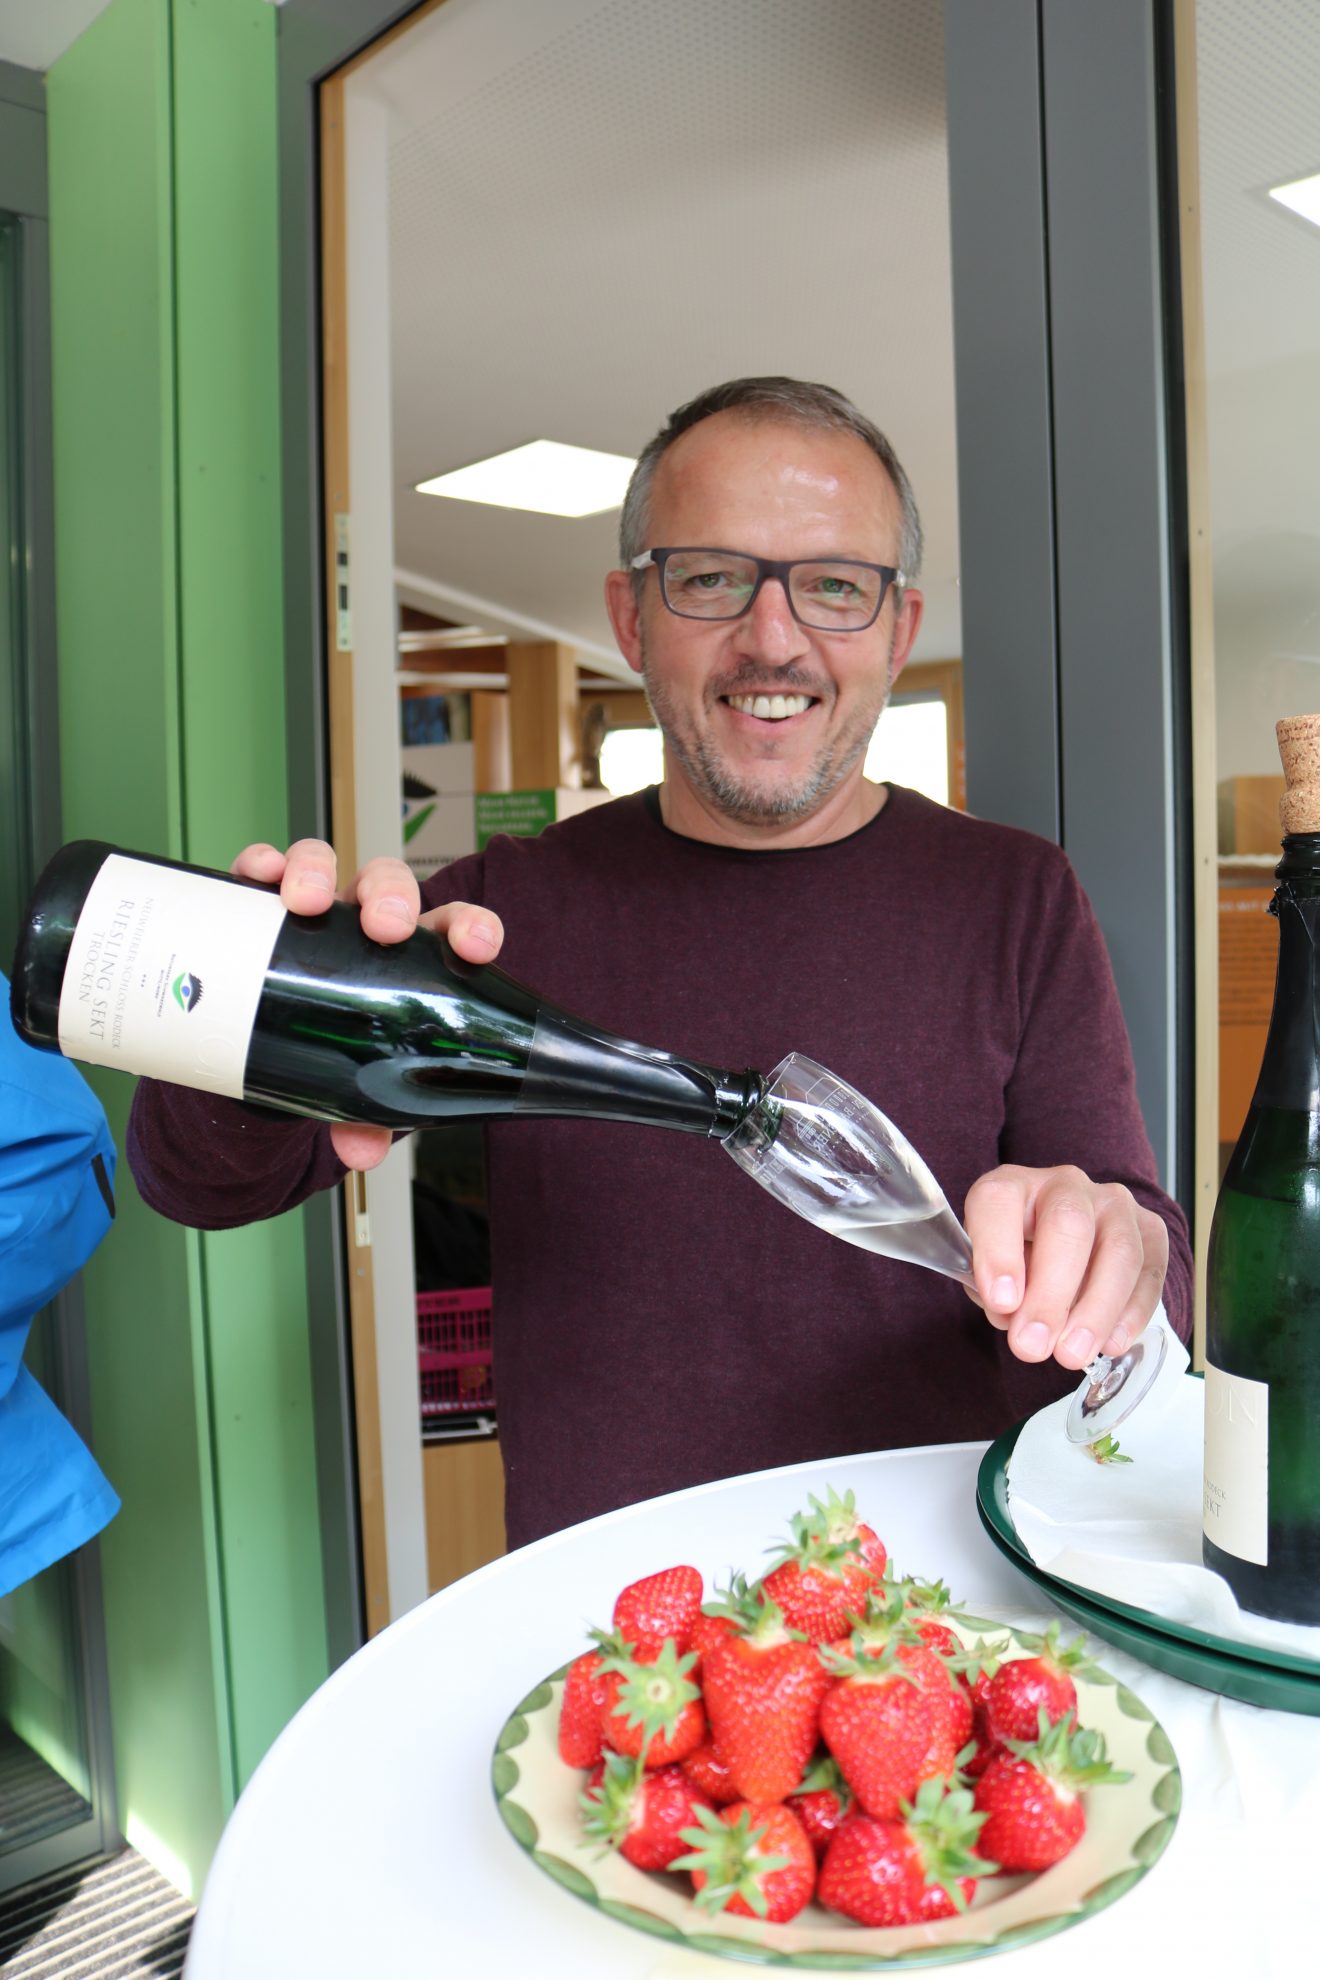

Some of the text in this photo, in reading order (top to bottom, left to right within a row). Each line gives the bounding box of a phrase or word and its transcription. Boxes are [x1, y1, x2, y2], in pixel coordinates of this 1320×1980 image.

[79, 931, 105, 1003] TROCKEN
[90, 899, 135, 1040] RIESLING SEKT
[116, 964, 133, 1015] SCHLOSS
[112, 1014, 123, 1049] RODECK
